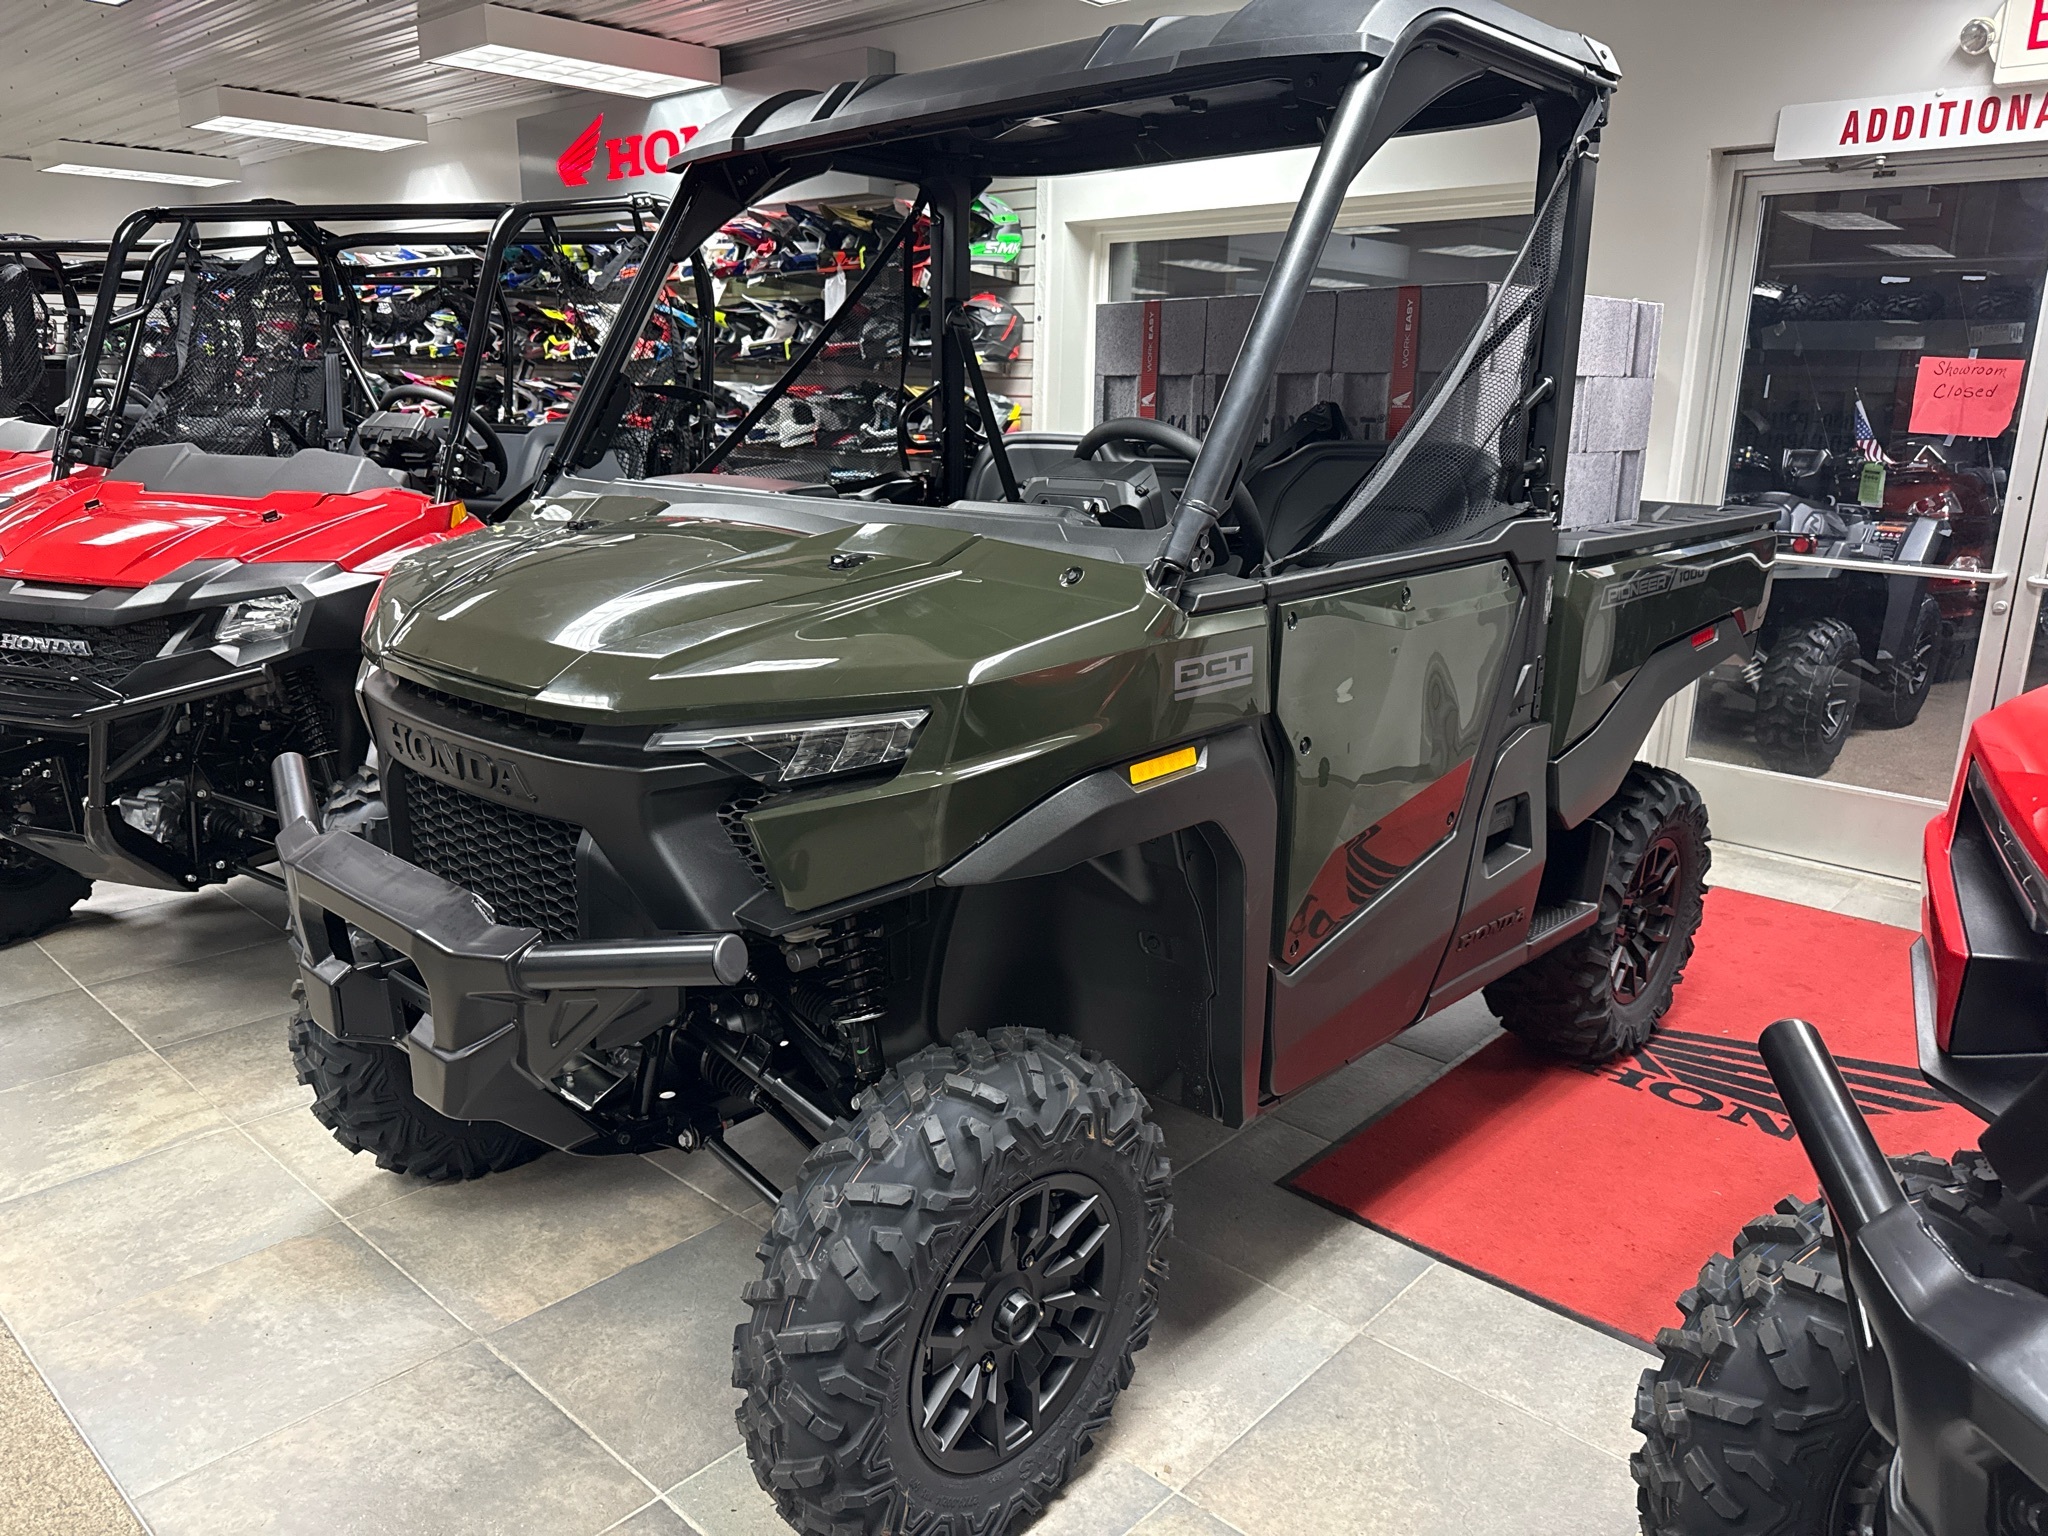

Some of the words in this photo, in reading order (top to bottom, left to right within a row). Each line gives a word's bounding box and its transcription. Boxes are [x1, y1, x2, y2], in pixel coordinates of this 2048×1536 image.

[605, 124, 702, 181] HO
[1404, 299, 1414, 332] EASY
[1401, 334, 1411, 369] WORK
[1933, 360, 2008, 379] Showroom
[1933, 383, 1999, 399] Closed
[1607, 573, 1668, 603] PIONEER
[1679, 569, 1705, 583] 1000
[1, 633, 93, 656] HONDA
[1180, 652, 1249, 683] DCT
[388, 717, 538, 802] HONDA
[1456, 906, 1528, 952] HONDA
